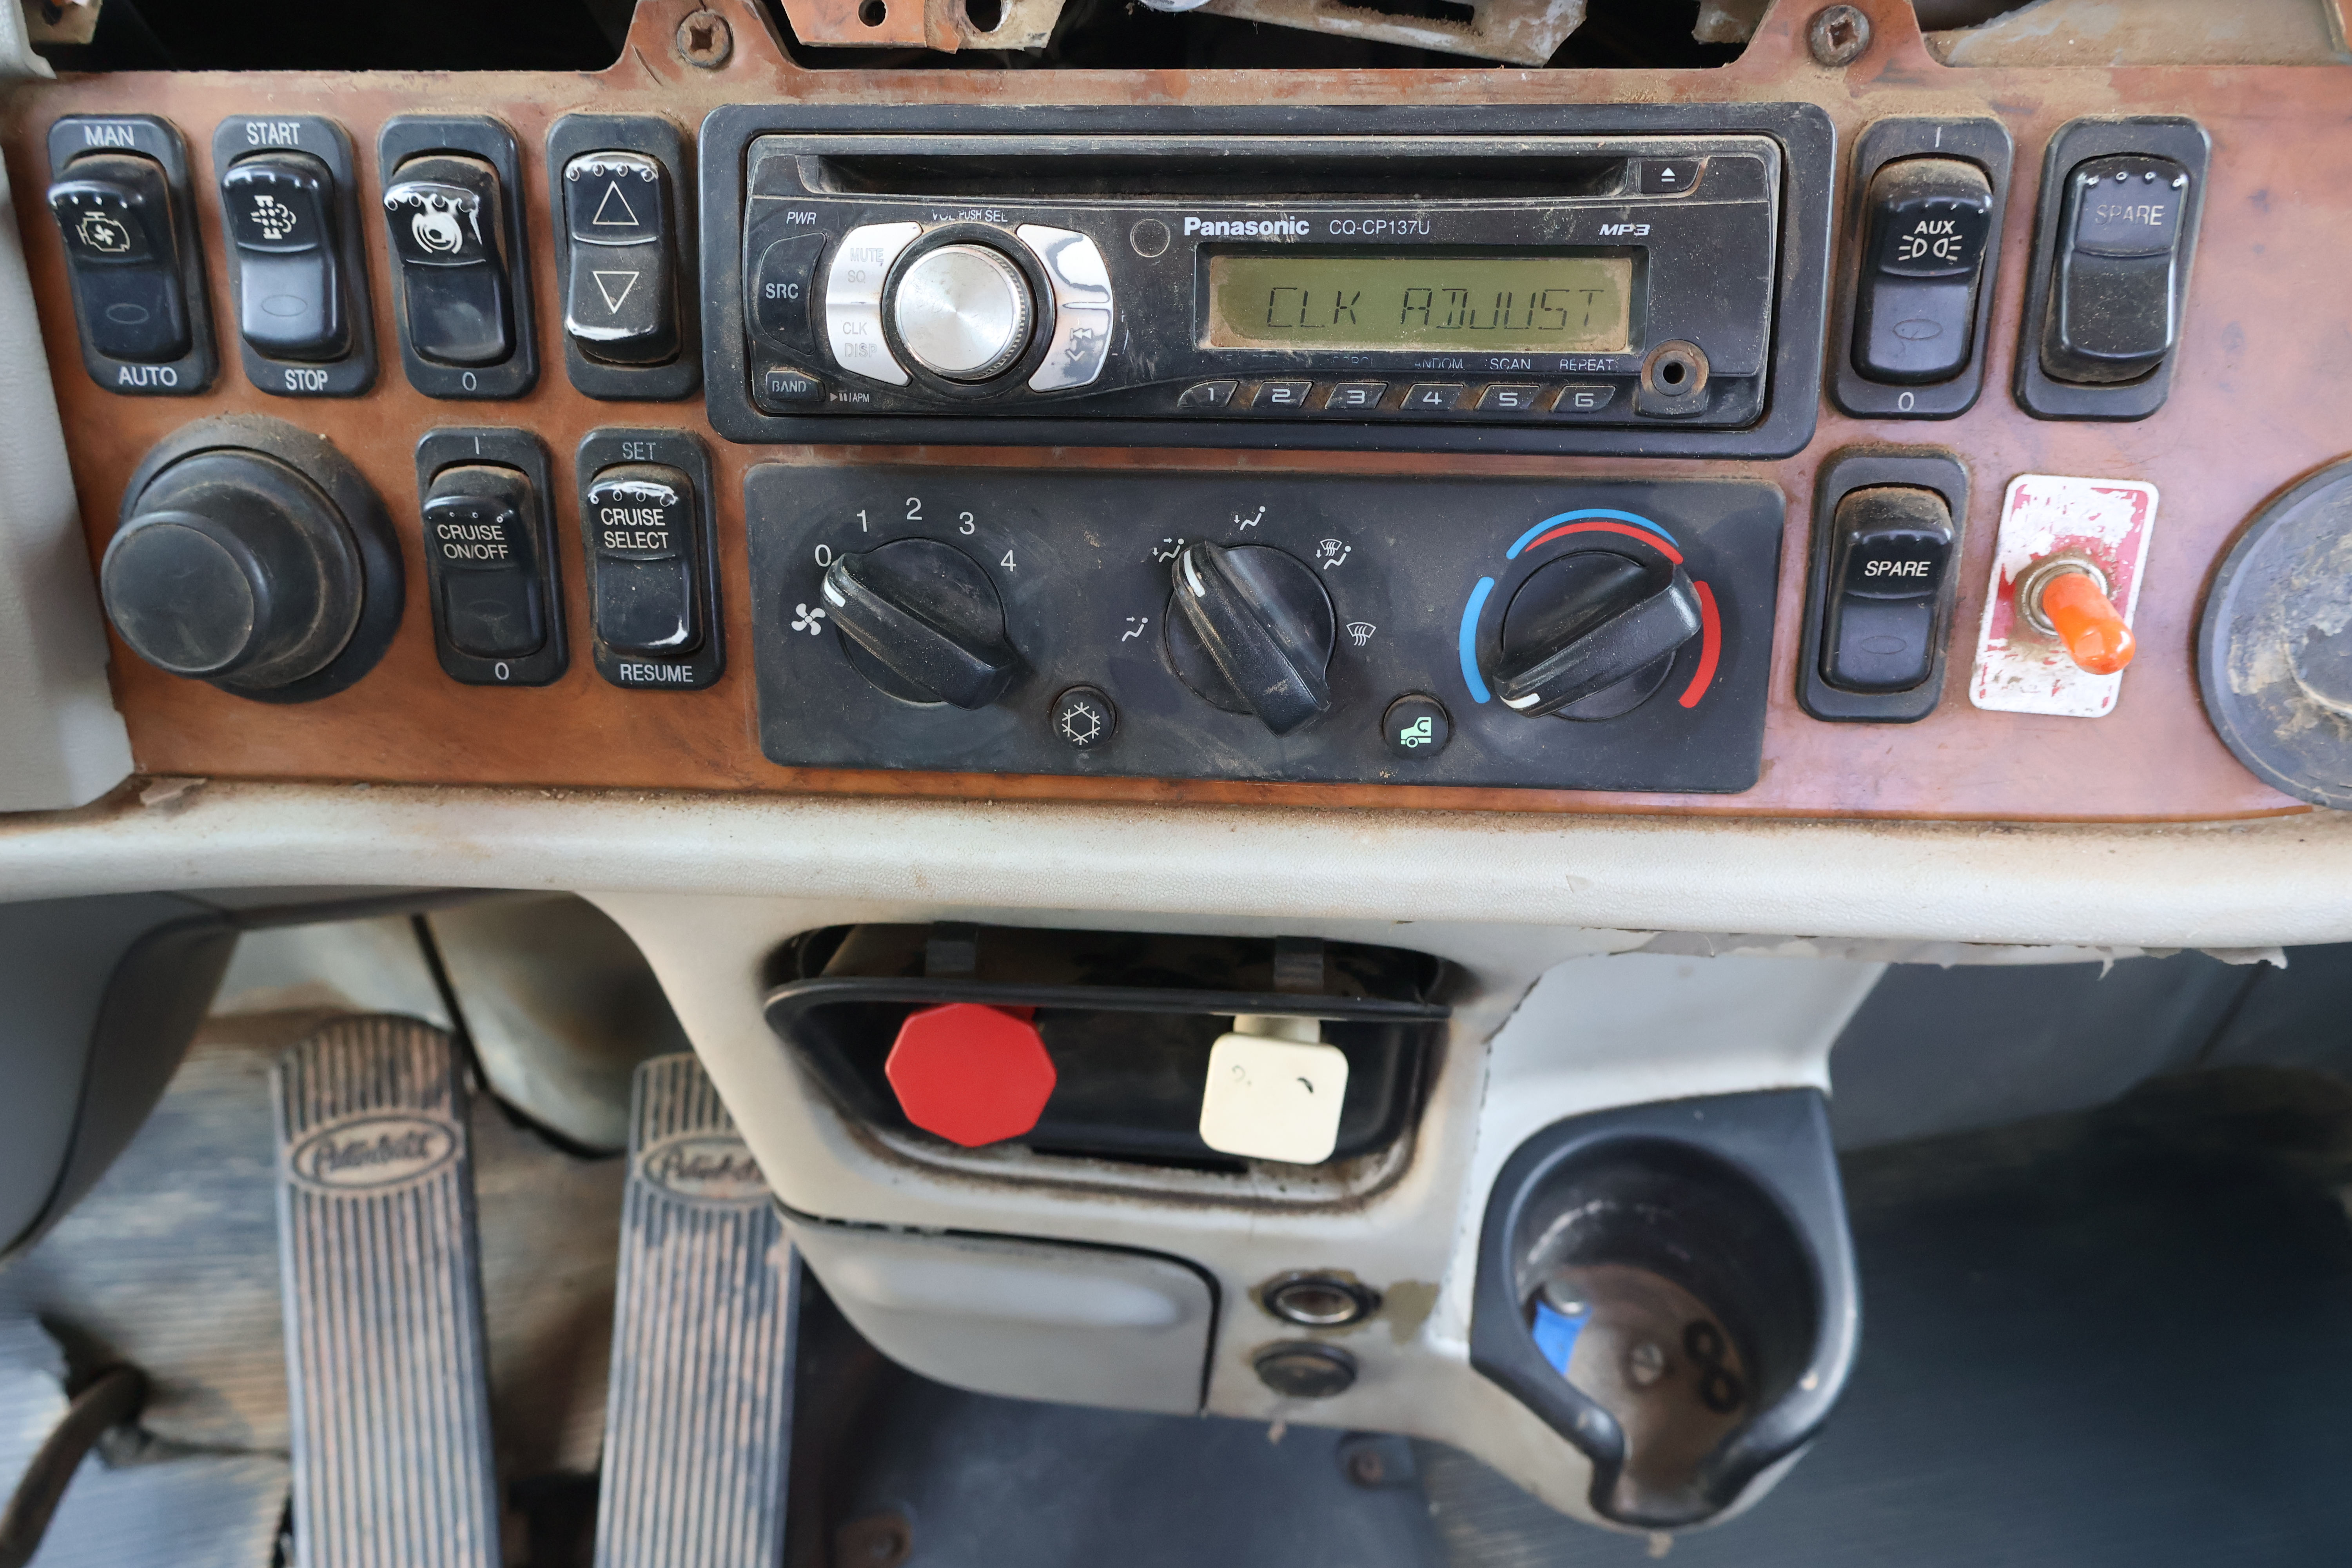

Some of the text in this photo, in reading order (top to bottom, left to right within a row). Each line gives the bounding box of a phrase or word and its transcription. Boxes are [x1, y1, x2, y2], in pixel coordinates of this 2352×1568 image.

[85, 126, 135, 146] MAN
[247, 122, 300, 145] START
[786, 212, 816, 224] PWR
[958, 208, 982, 220] PUSH
[985, 210, 1008, 222] SEL
[2094, 204, 2165, 226] SPARE
[1184, 215, 1429, 237] Panasonic CQ-CP137U
[1599, 223, 1650, 236] MP3
[1914, 221, 1955, 234] AUX
[850, 248, 884, 262] MUTE
[848, 270, 866, 283] SQ
[766, 283, 798, 299] SRC
[1266, 287, 1604, 330] CLK ADJUST
[843, 321, 867, 335] CLK
[844, 343, 878, 358] DISP
[1491, 358, 1530, 369] SCAN
[1560, 359, 1614, 371] REPEAT
[119, 367, 177, 386] AUTO
[285, 369, 328, 390] STOP
[773, 380, 806, 392] BAND
[1208, 388, 1214, 401] 1
[1272, 388, 1290, 403] 2
[1347, 390, 1365, 403] 3
[1423, 392, 1442, 405] 4
[1499, 392, 1517, 406] 5
[1575, 393, 1593, 407] 6
[622, 442, 656, 460] SET
[601, 508, 665, 526] CRUISE
[437, 524, 505, 540] CRUISE
[815, 497, 1016, 572] 0 1 2 3 4
[604, 531, 668, 549] SELECT
[444, 544, 508, 559] ON/OFF
[1865, 561, 1931, 576] SPARE
[621, 664, 693, 682] RESUME
